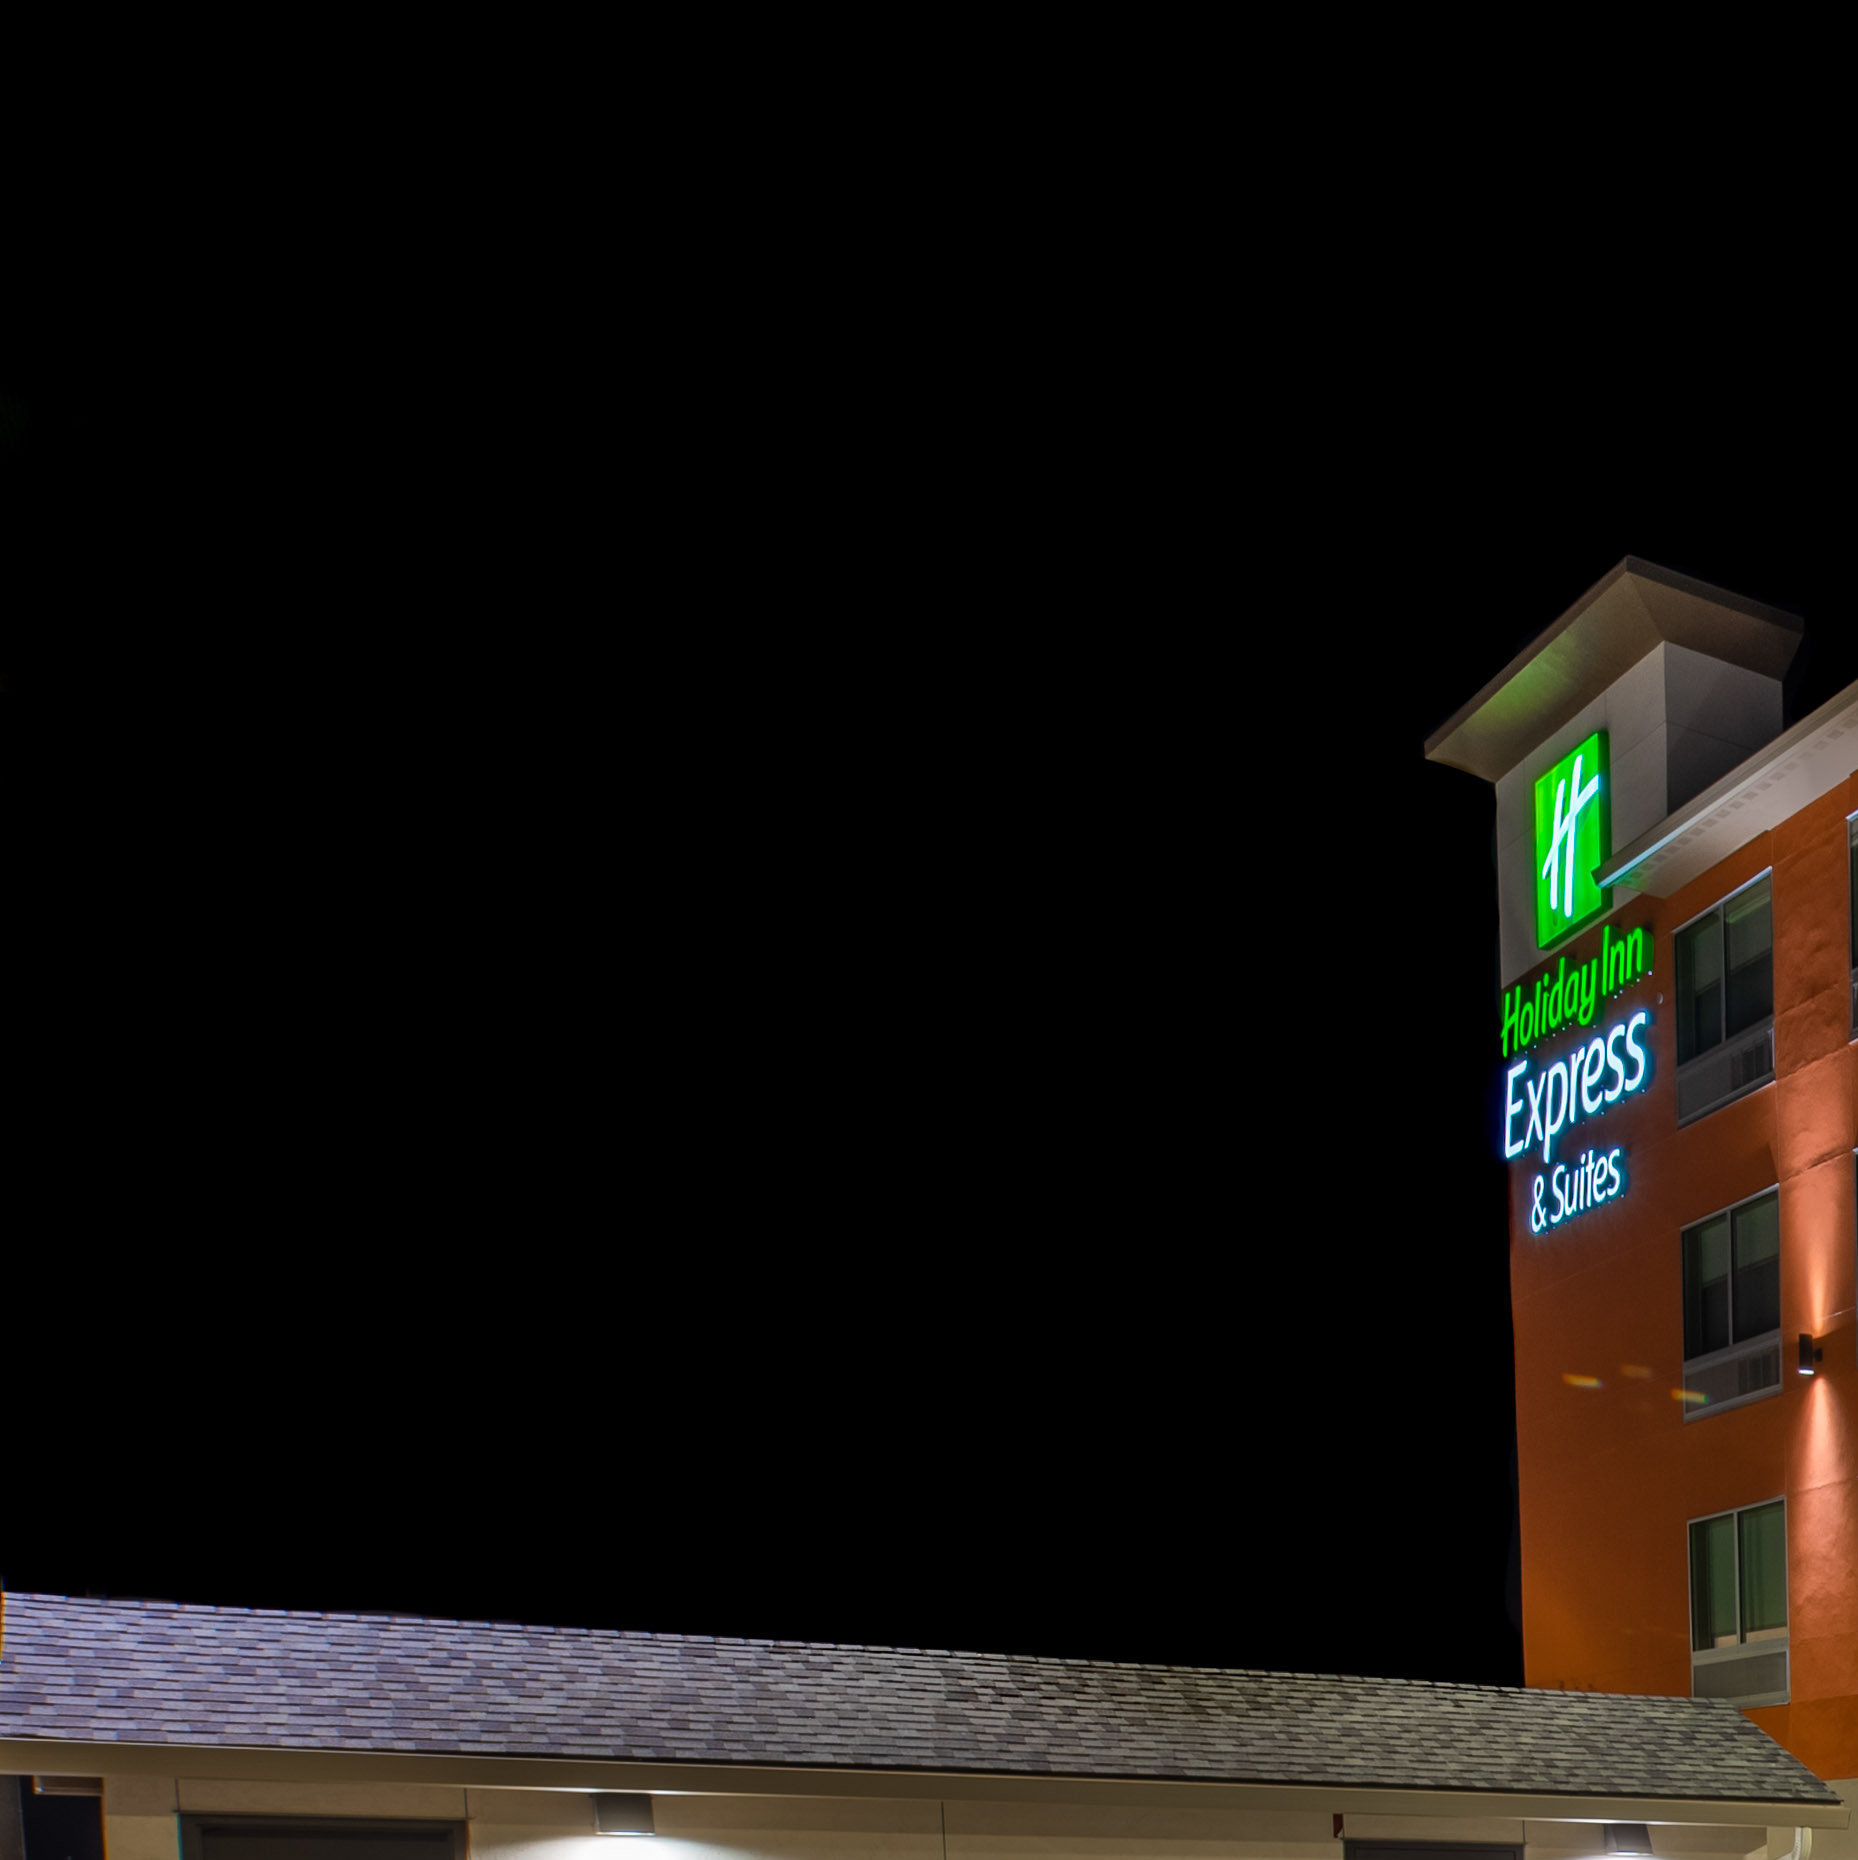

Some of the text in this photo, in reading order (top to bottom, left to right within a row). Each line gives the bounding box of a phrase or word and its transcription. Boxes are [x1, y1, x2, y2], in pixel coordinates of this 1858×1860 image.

[1501, 925, 1643, 1058] Holiday Inn
[1504, 1012, 1646, 1162] Express
[1530, 1148, 1621, 1233] & Suites
